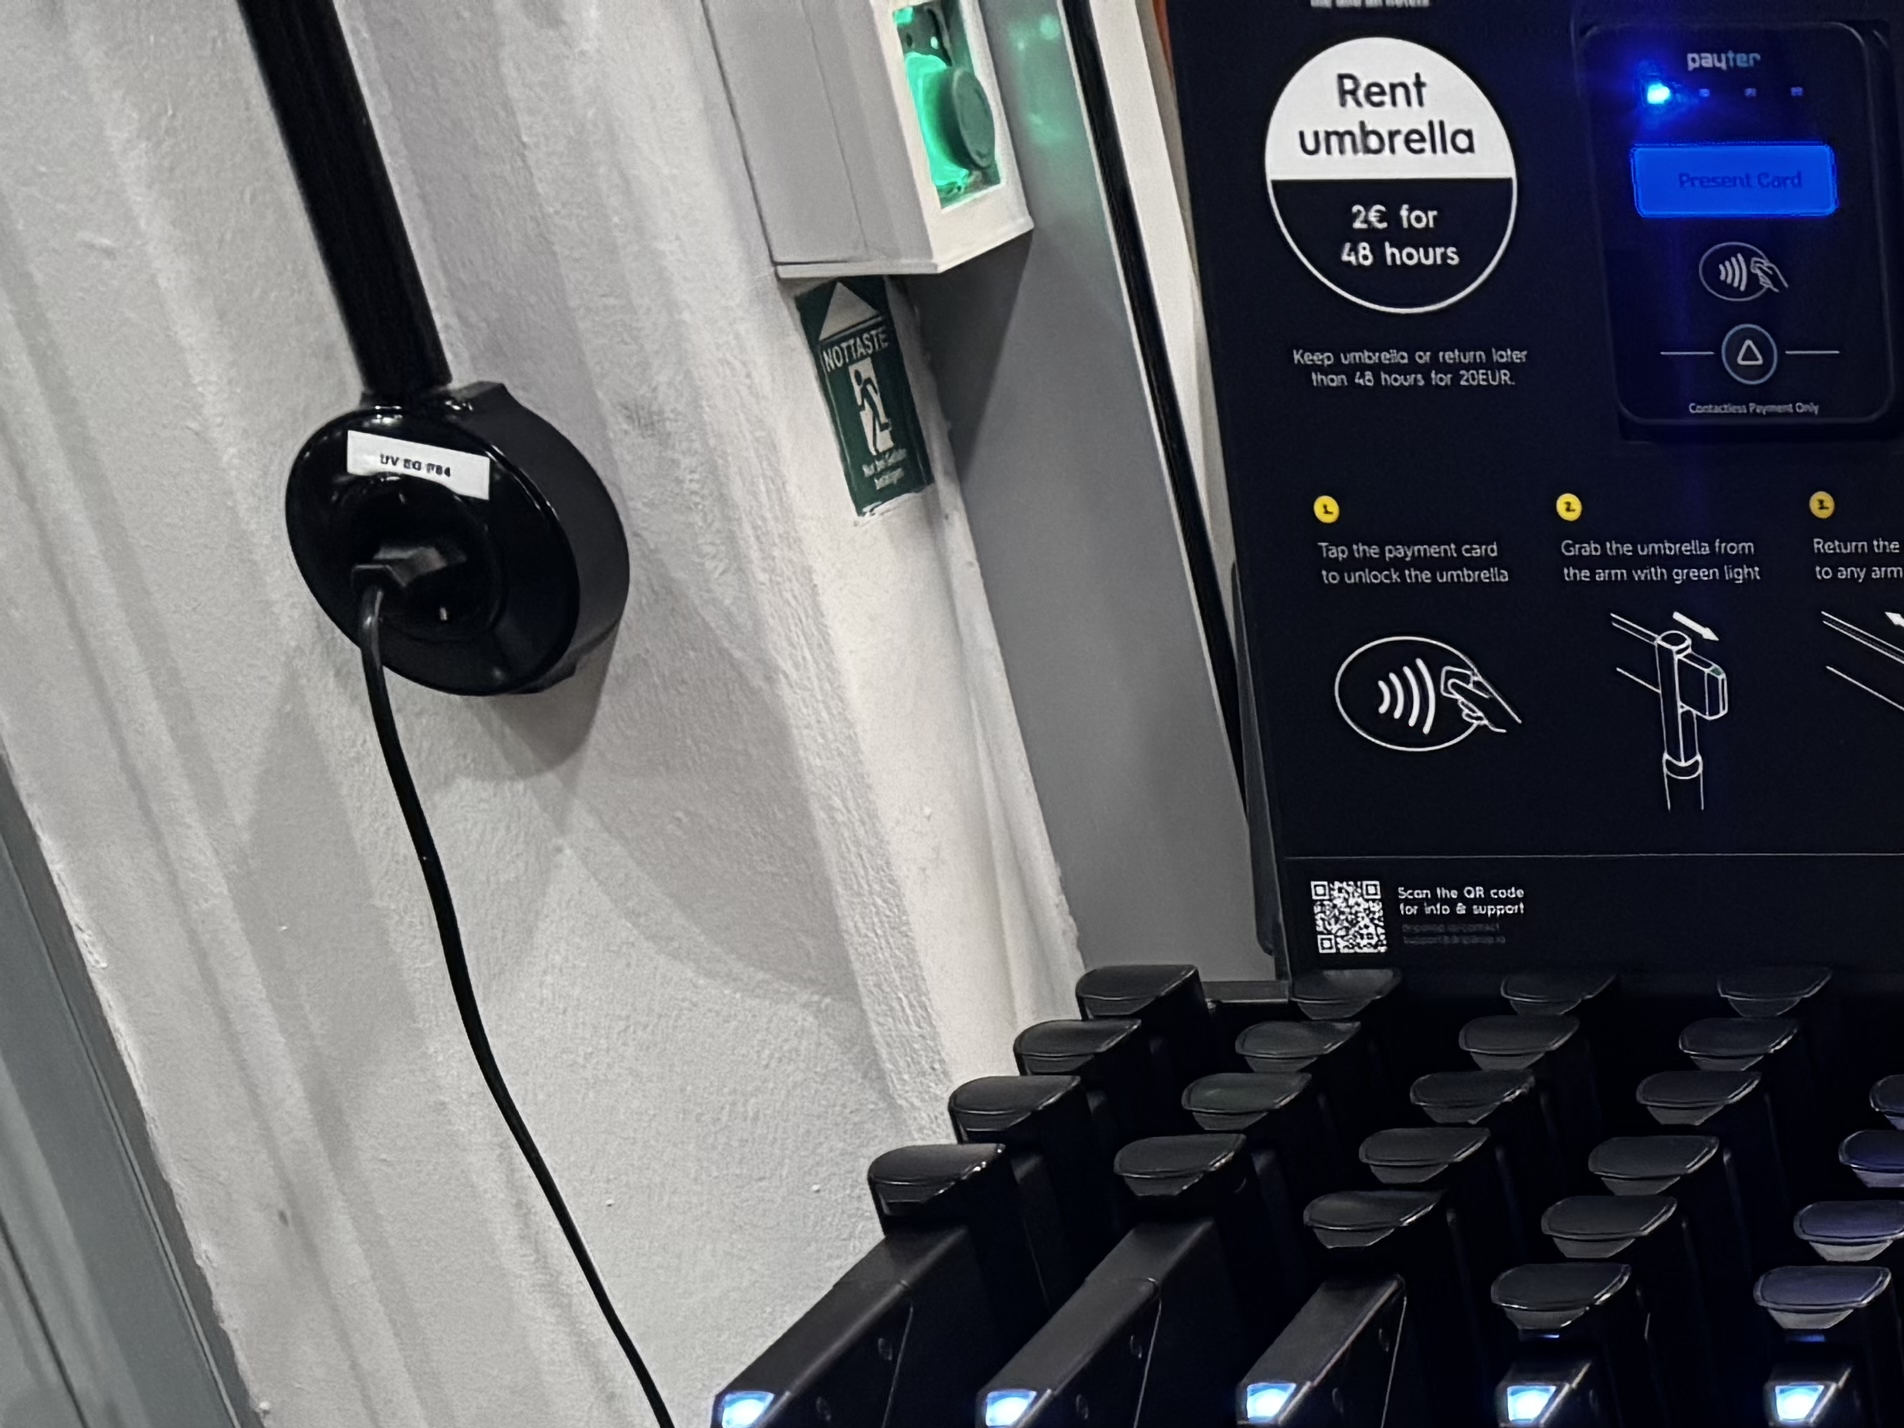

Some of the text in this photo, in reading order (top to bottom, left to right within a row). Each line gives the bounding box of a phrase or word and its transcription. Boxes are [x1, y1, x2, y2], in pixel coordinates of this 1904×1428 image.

[1687, 50, 1761, 71] payter
[1337, 74, 1427, 108] Rent
[1298, 121, 1475, 157] umbrella
[1679, 171, 1802, 188] Present Card
[1351, 204, 1438, 230] 2€ for
[1341, 242, 1460, 268] 48 hours
[822, 327, 889, 373] NOTTASTE
[1293, 348, 1528, 366] Keep umbrella or return later
[1312, 370, 1516, 386] than 48 hours for 20EUR.
[1689, 401, 1820, 417] Contactless Payment Only
[1318, 541, 1498, 562] Tap the payment card
[1561, 539, 1754, 556] Grab the umbrella from
[1813, 538, 1868, 553] Return
[1873, 538, 1900, 553] the
[1321, 568, 1509, 583] to unlock the umbrella
[1564, 564, 1760, 587] the arm with green light
[1816, 565, 1832, 579] to
[1837, 566, 1866, 583] any
[1871, 566, 1903, 579] arm
[1398, 886, 1525, 899] Scan the QR code
[1400, 902, 1525, 918] for info & support
